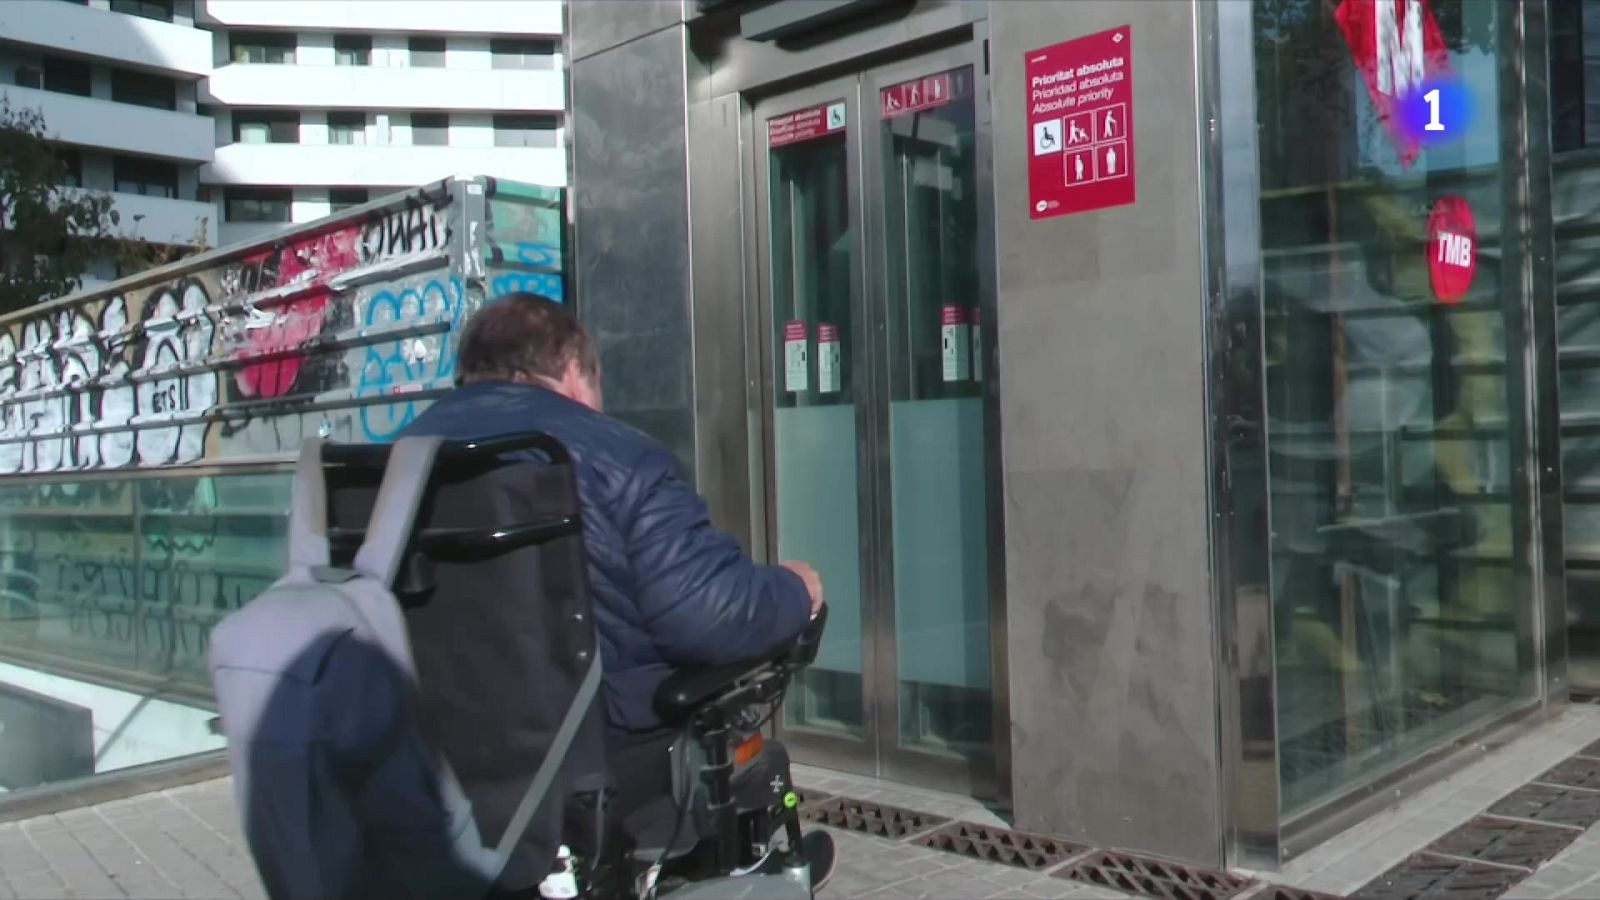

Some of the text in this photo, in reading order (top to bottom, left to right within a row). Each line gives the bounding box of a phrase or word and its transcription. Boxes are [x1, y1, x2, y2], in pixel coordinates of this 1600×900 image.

[1375, 0, 1424, 99] M
[1032, 57, 1124, 88] Prioritat absoluta
[1032, 71, 1124, 101] Prioridad absoluta
[1032, 88, 1114, 114] Absolute priority
[1437, 231, 1471, 267] TMB
